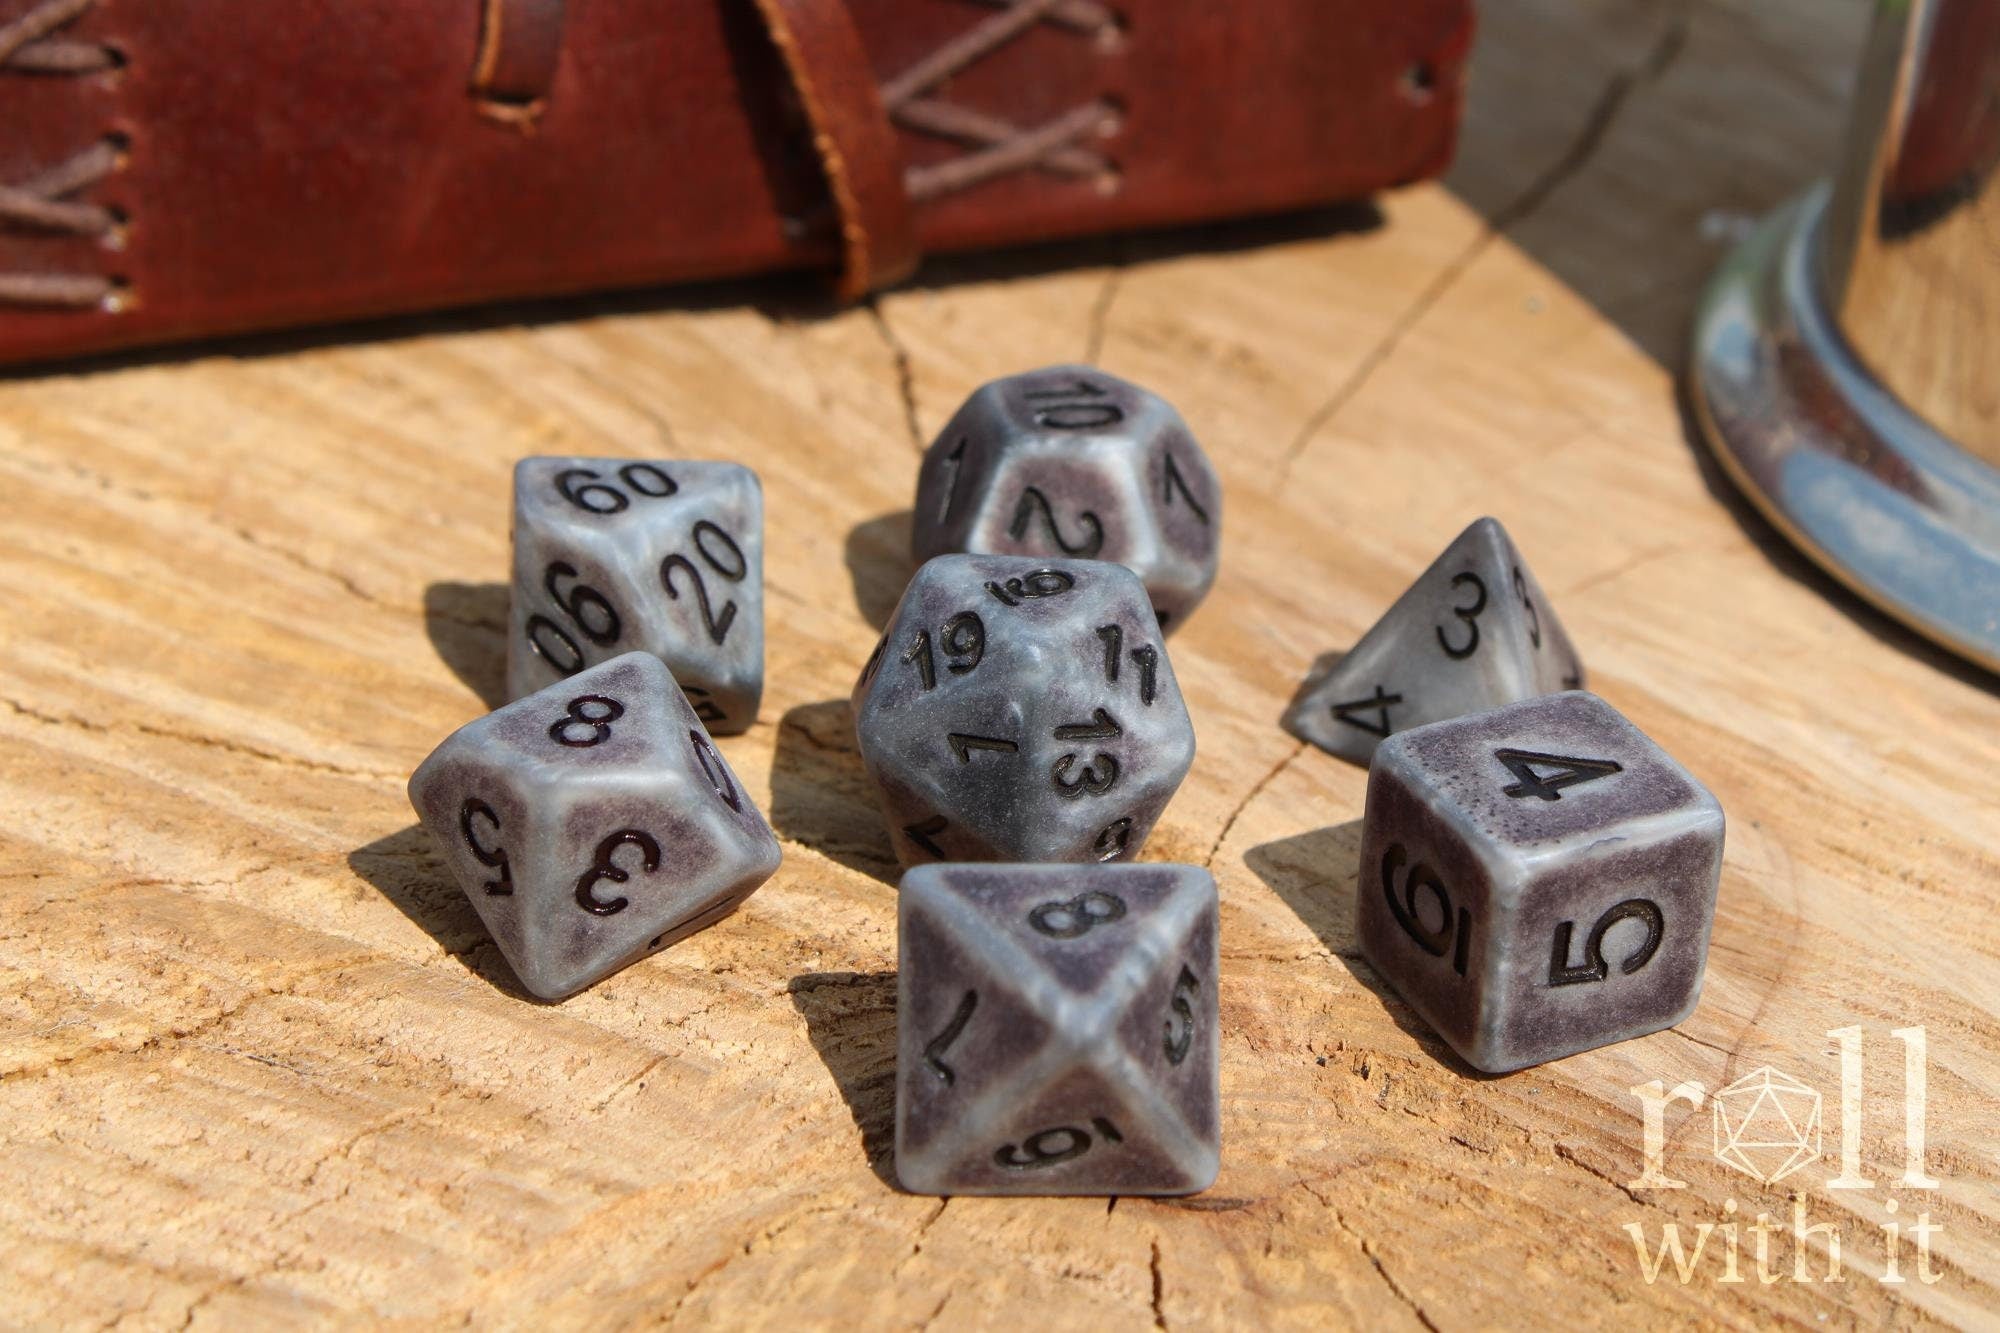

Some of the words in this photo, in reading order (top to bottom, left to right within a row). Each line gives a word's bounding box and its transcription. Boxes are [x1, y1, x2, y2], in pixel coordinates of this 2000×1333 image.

[1024, 381, 1122, 429] 10
[554, 463, 678, 514] 60
[1008, 485, 1104, 559] 2
[660, 520, 747, 646] 20
[1436, 572, 1488, 660] 3
[902, 611, 986, 691] 19
[1097, 624, 1158, 706] 11
[549, 694, 625, 748] 8
[1331, 685, 1403, 738] 4
[1053, 708, 1122, 798] 13
[1494, 748, 1623, 801] 4
[460, 797, 513, 897] 5
[575, 829, 662, 917] 3
[1028, 890, 1127, 939] 8
[1548, 898, 1664, 989] 5
